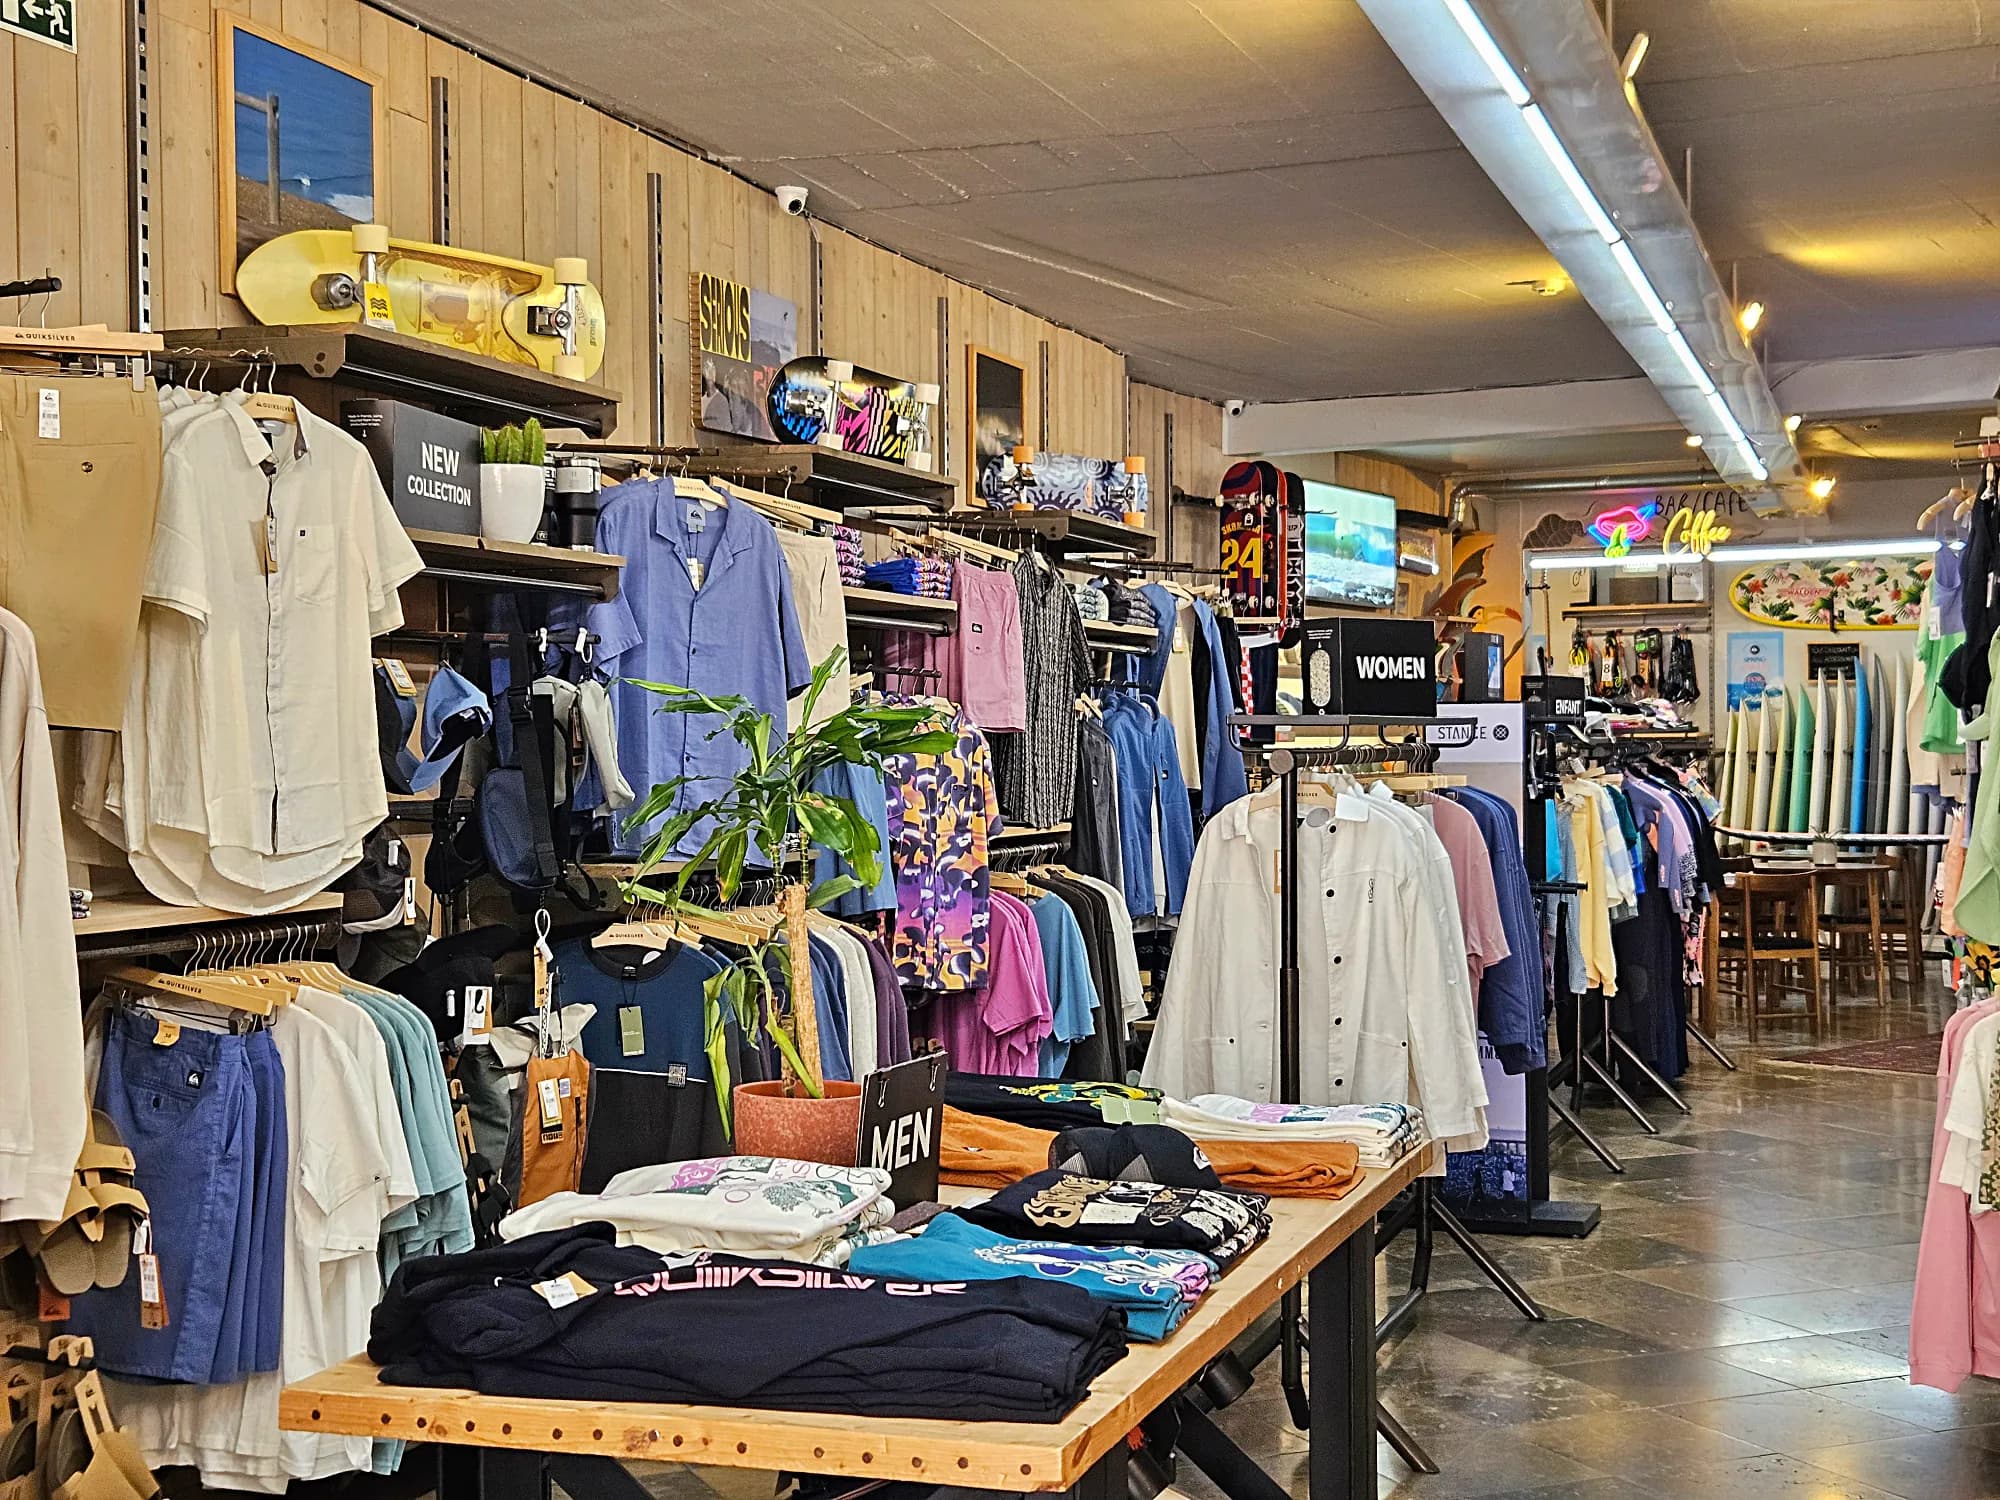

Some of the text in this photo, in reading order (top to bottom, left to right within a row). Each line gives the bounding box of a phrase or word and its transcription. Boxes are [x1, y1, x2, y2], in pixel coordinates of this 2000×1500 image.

[371, 311, 389, 319] YOW
[700, 273, 750, 361] SERIOUS
[25, 333, 76, 341] QUIKSILVER
[261, 402, 295, 413] QUIKSILVER
[421, 441, 460, 477] NEW
[406, 474, 472, 506] COLLECTION
[1662, 507, 1732, 557] Coffee
[1221, 537, 1261, 579] 24
[1355, 655, 1426, 680] WOMEN
[1603, 663, 1610, 674] 8
[1555, 699, 1581, 715] ENFANT
[1437, 726, 1487, 740] STANCE
[166, 980, 203, 994] QUIKSILVER
[871, 1107, 933, 1172] MEN
